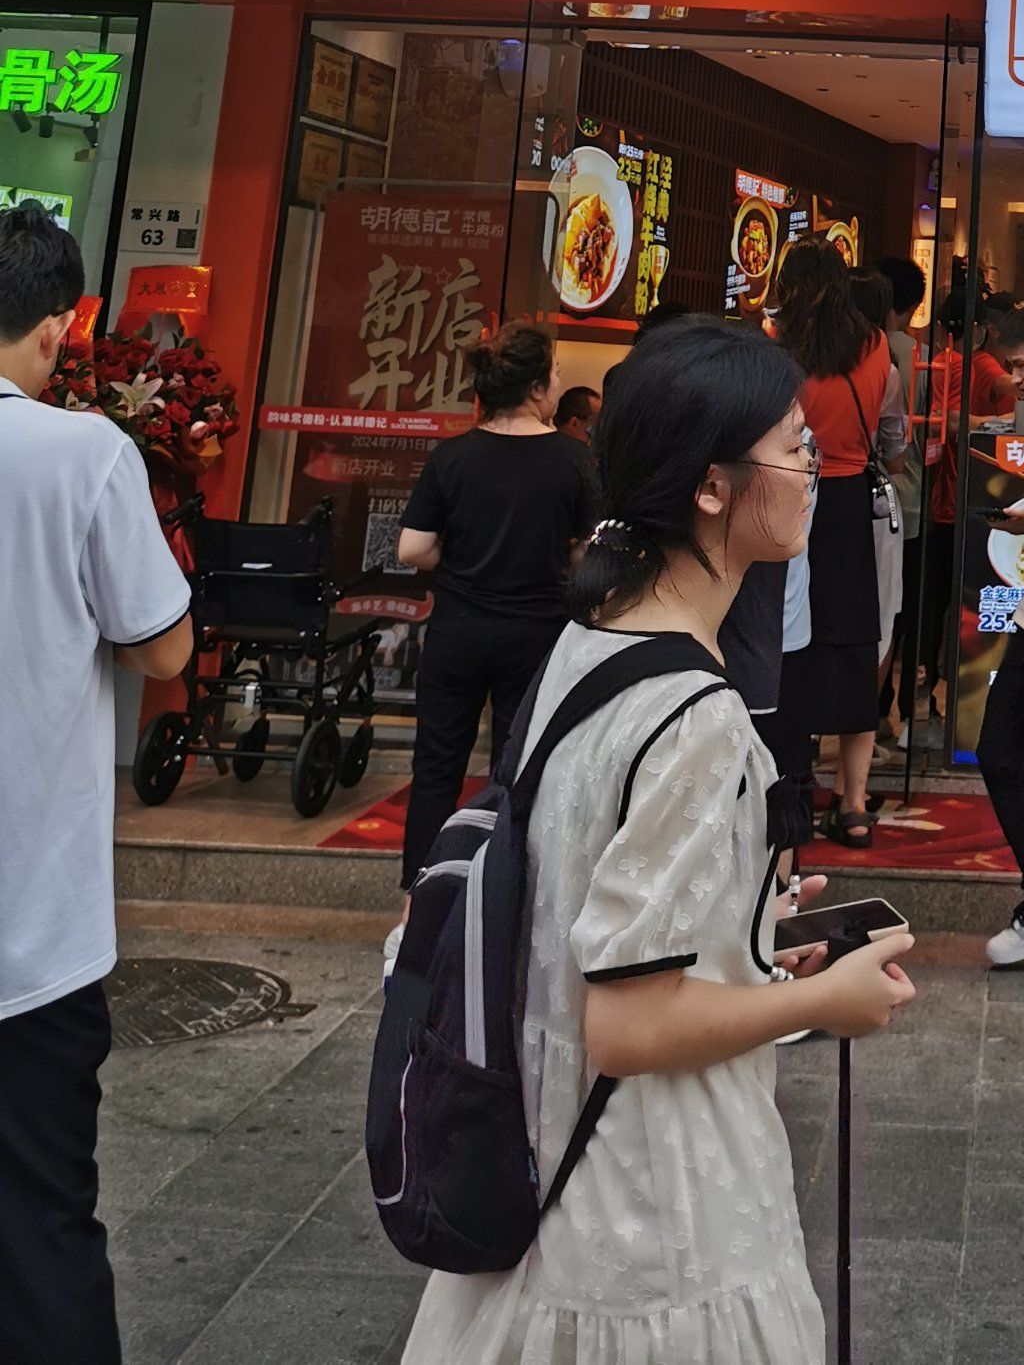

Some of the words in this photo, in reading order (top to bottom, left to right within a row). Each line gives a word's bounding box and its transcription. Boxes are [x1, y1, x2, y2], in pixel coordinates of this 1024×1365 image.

[0, 48, 123, 115] 骨汤
[130, 206, 182, 224] 常兴路
[140, 228, 165, 247] 63
